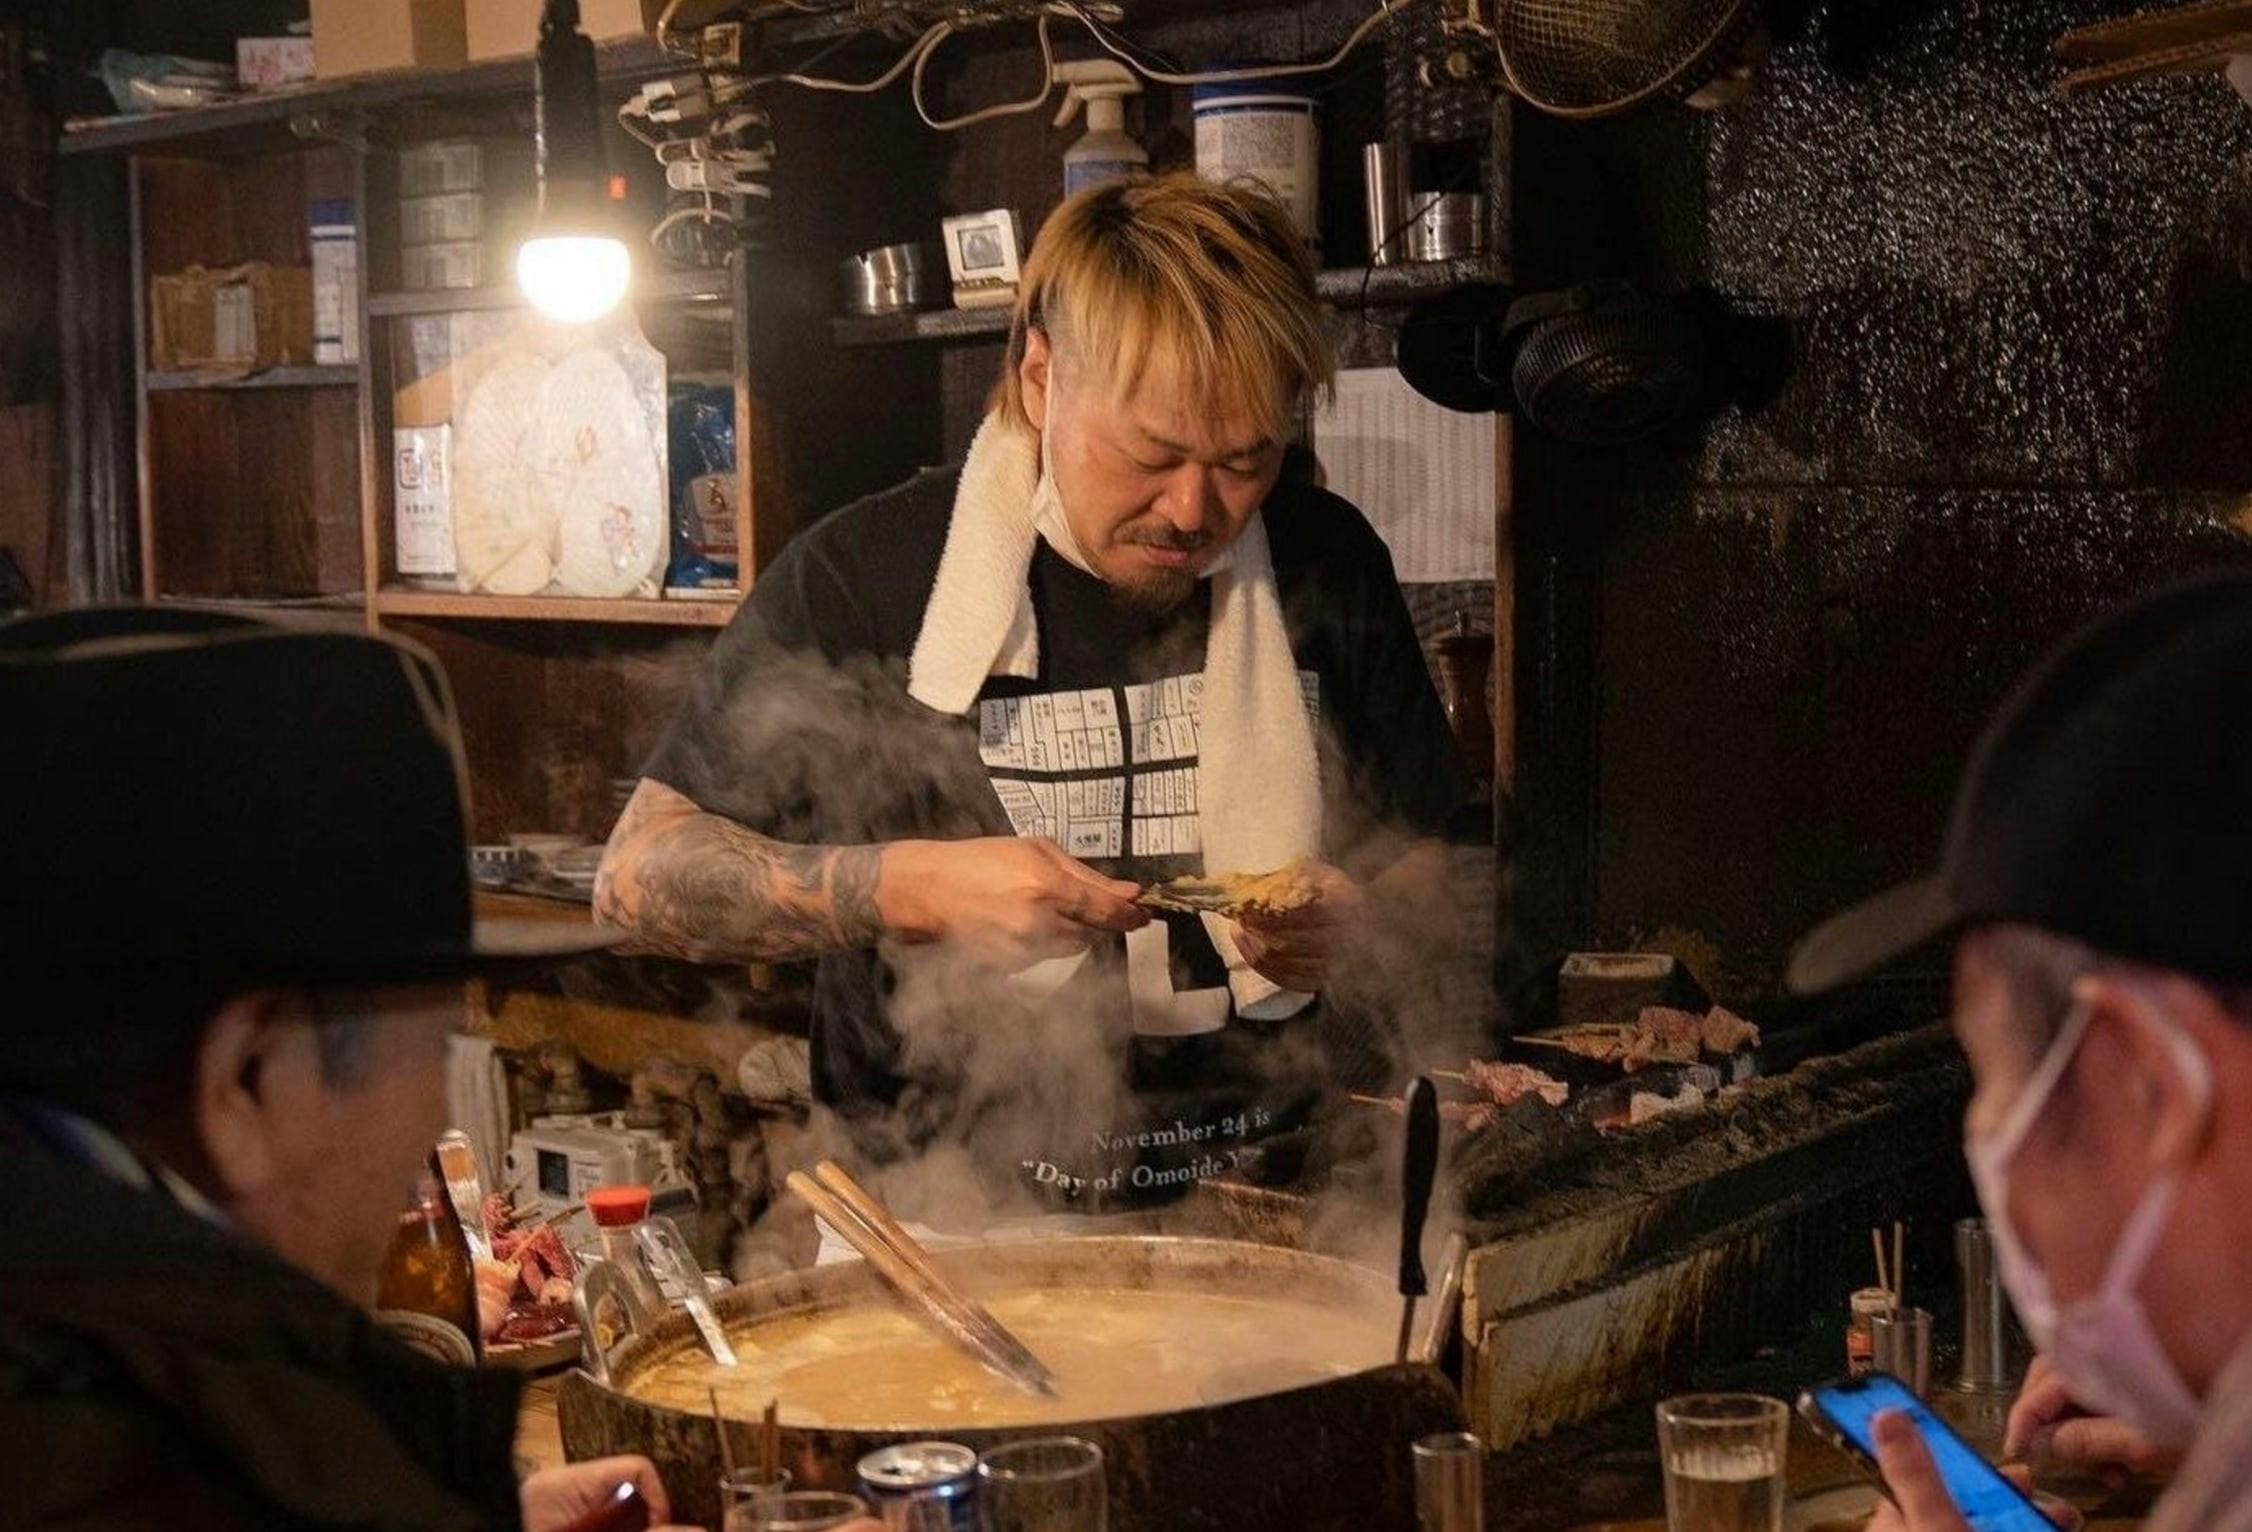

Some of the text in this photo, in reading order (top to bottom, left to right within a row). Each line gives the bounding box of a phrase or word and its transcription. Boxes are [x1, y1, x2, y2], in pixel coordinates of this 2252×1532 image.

[1093, 1107, 1271, 1152] November 24 is
[1094, 1169, 1121, 1191] of
[1131, 1155, 1224, 1188] Omoide
